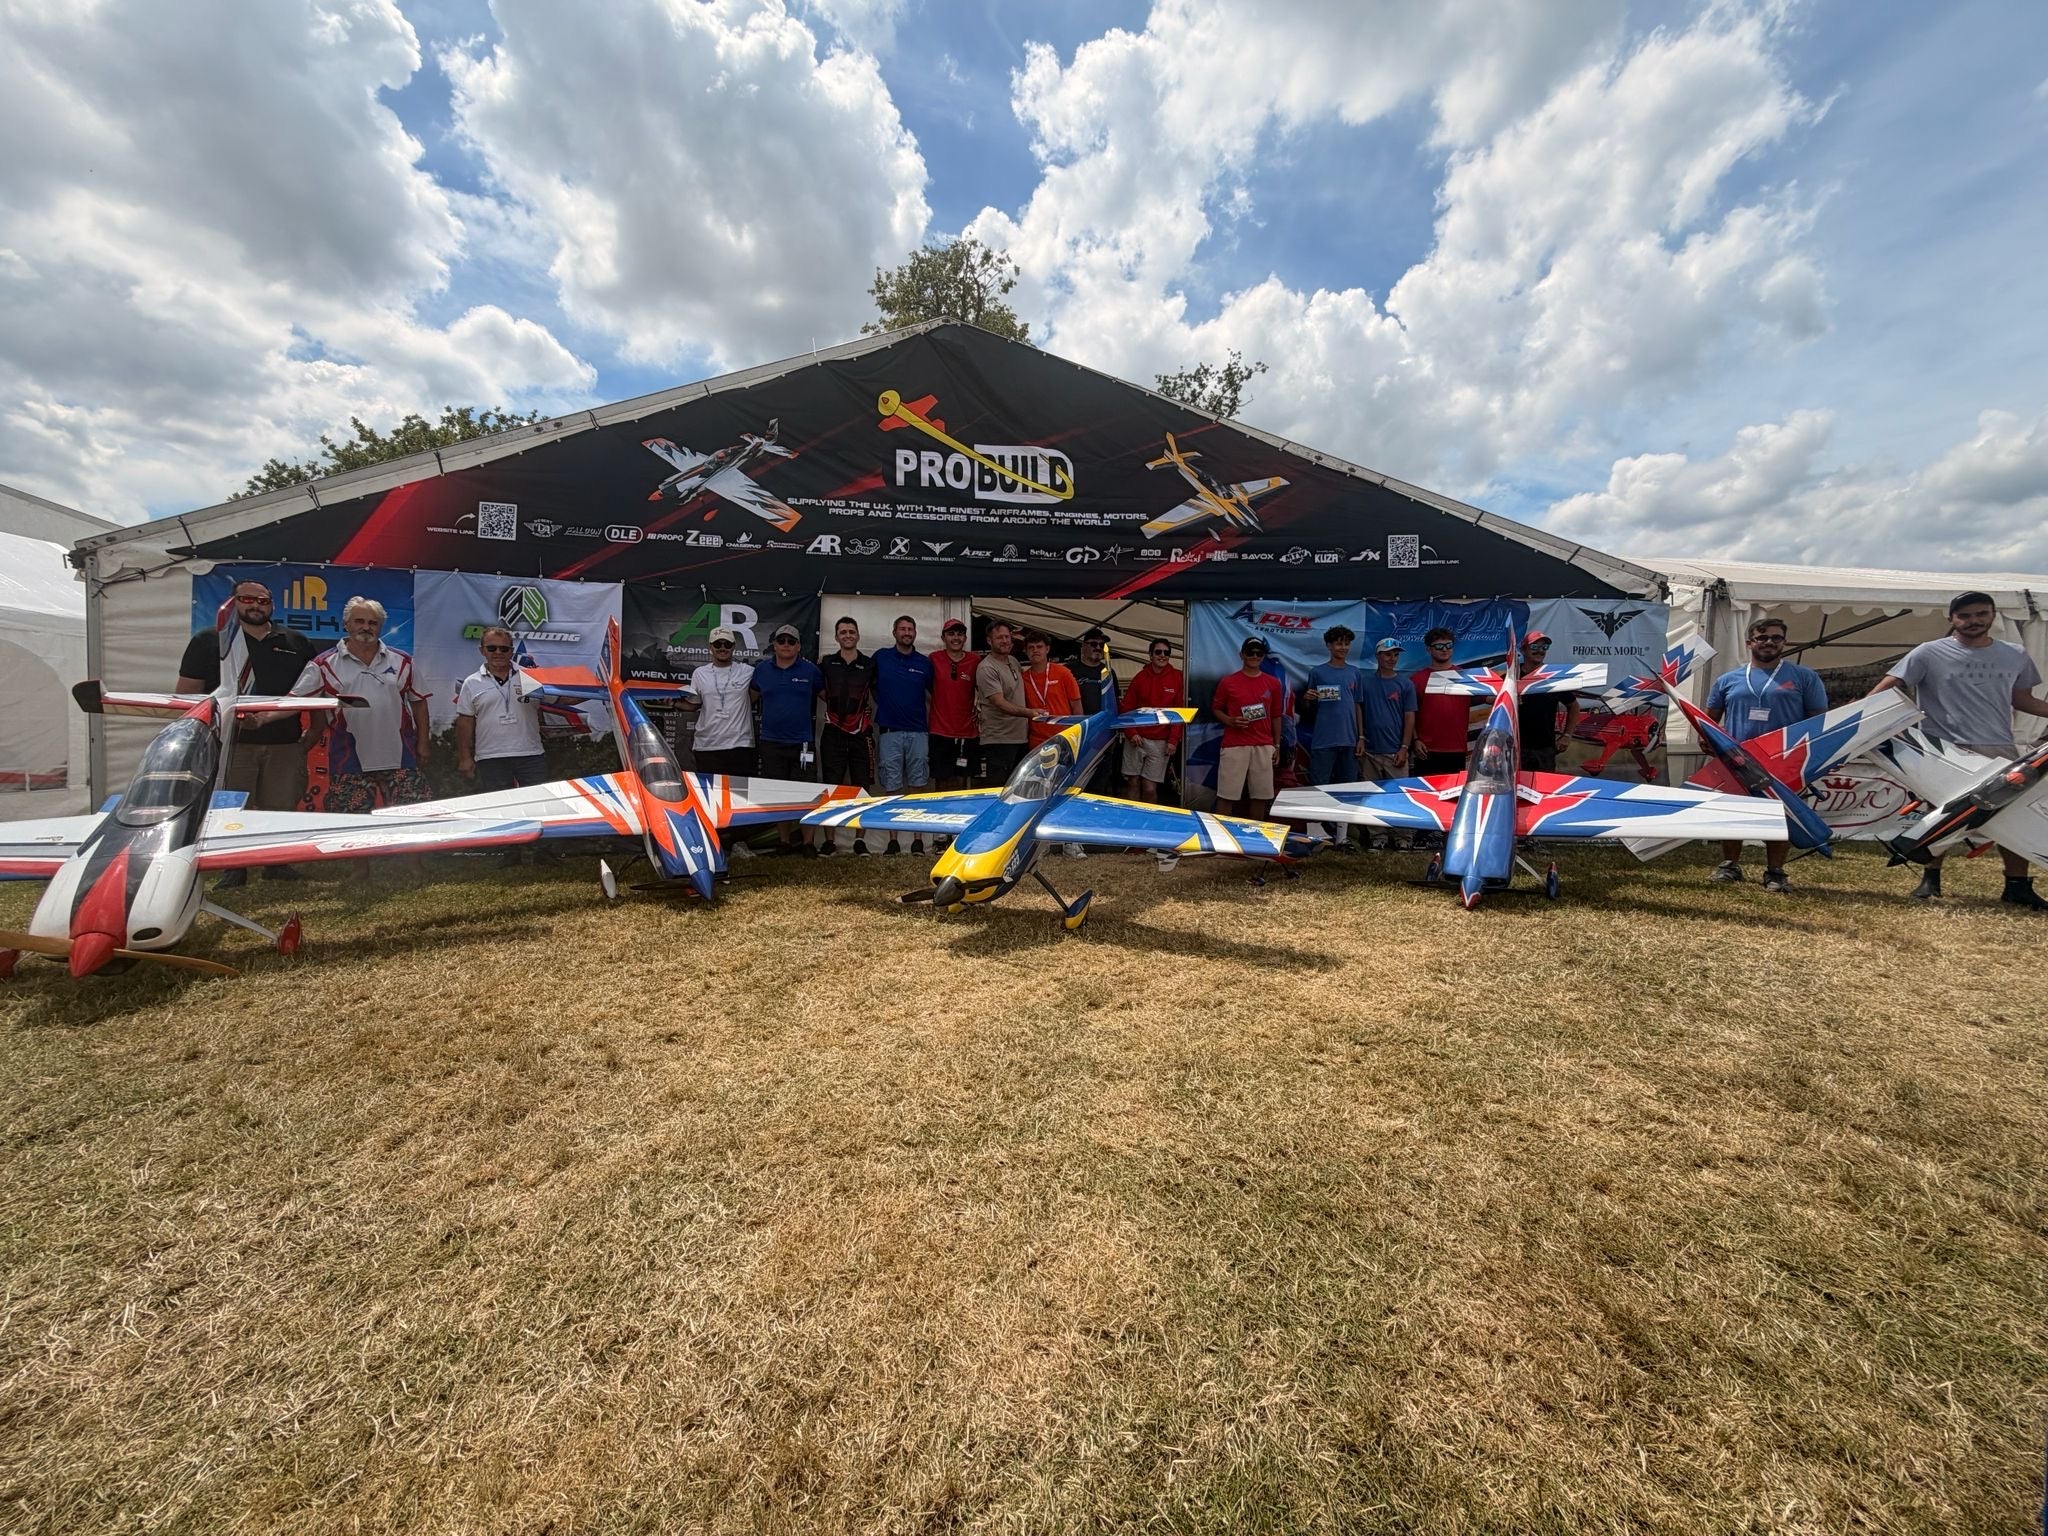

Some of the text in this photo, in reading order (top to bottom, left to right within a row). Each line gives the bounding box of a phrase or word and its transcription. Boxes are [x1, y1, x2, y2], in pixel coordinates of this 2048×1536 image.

[787, 498, 845, 507] SUPPLYING
[849, 501, 870, 509] THE
[873, 503, 893, 511] U.K.
[896, 504, 923, 512] WITH
[926, 505, 947, 513] THE
[950, 507, 986, 515] FINEST
[989, 509, 1051, 518] AIRFRAMES,
[1054, 511, 1101, 519] ENGINES,
[829, 508, 865, 516] PROPS
[868, 510, 892, 518] AND
[895, 512, 967, 521] ACCESSORIES
[970, 515, 1000, 523] FROM
[1002, 517, 1047, 525] AROUND
[426, 526, 457, 535] WEBSITE
[610, 528, 638, 540] DLE
[656, 533, 684, 541] PROPO
[686, 529, 720, 546] Zeee
[806, 534, 842, 552] AR
[1226, 602, 1315, 629] APEX
[667, 603, 759, 650] AR
[1572, 646, 1613, 656] PHOENIX
[631, 670, 667, 680] WHEN
